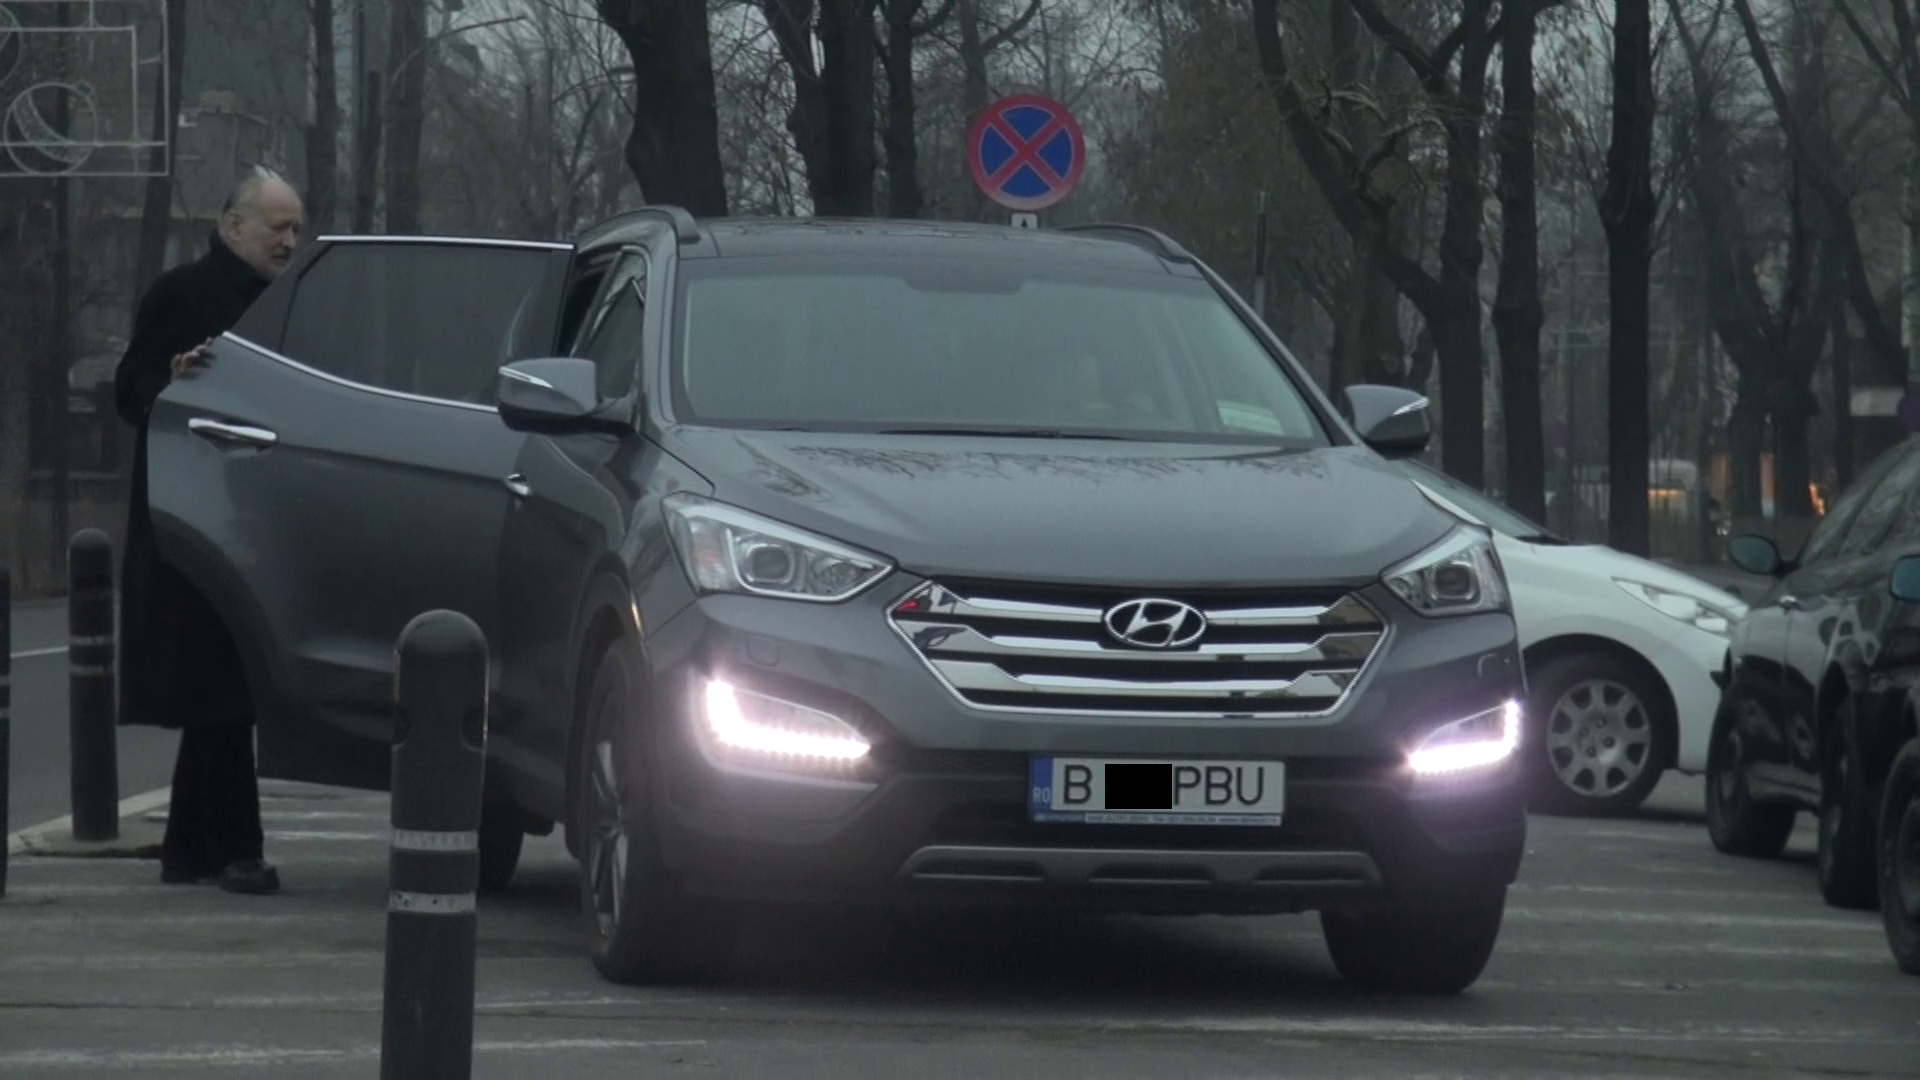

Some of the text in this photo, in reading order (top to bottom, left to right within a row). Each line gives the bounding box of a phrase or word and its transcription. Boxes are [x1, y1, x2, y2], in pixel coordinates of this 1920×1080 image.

[1033, 786, 1050, 803] RO
[1063, 764, 1265, 806] B PBU
